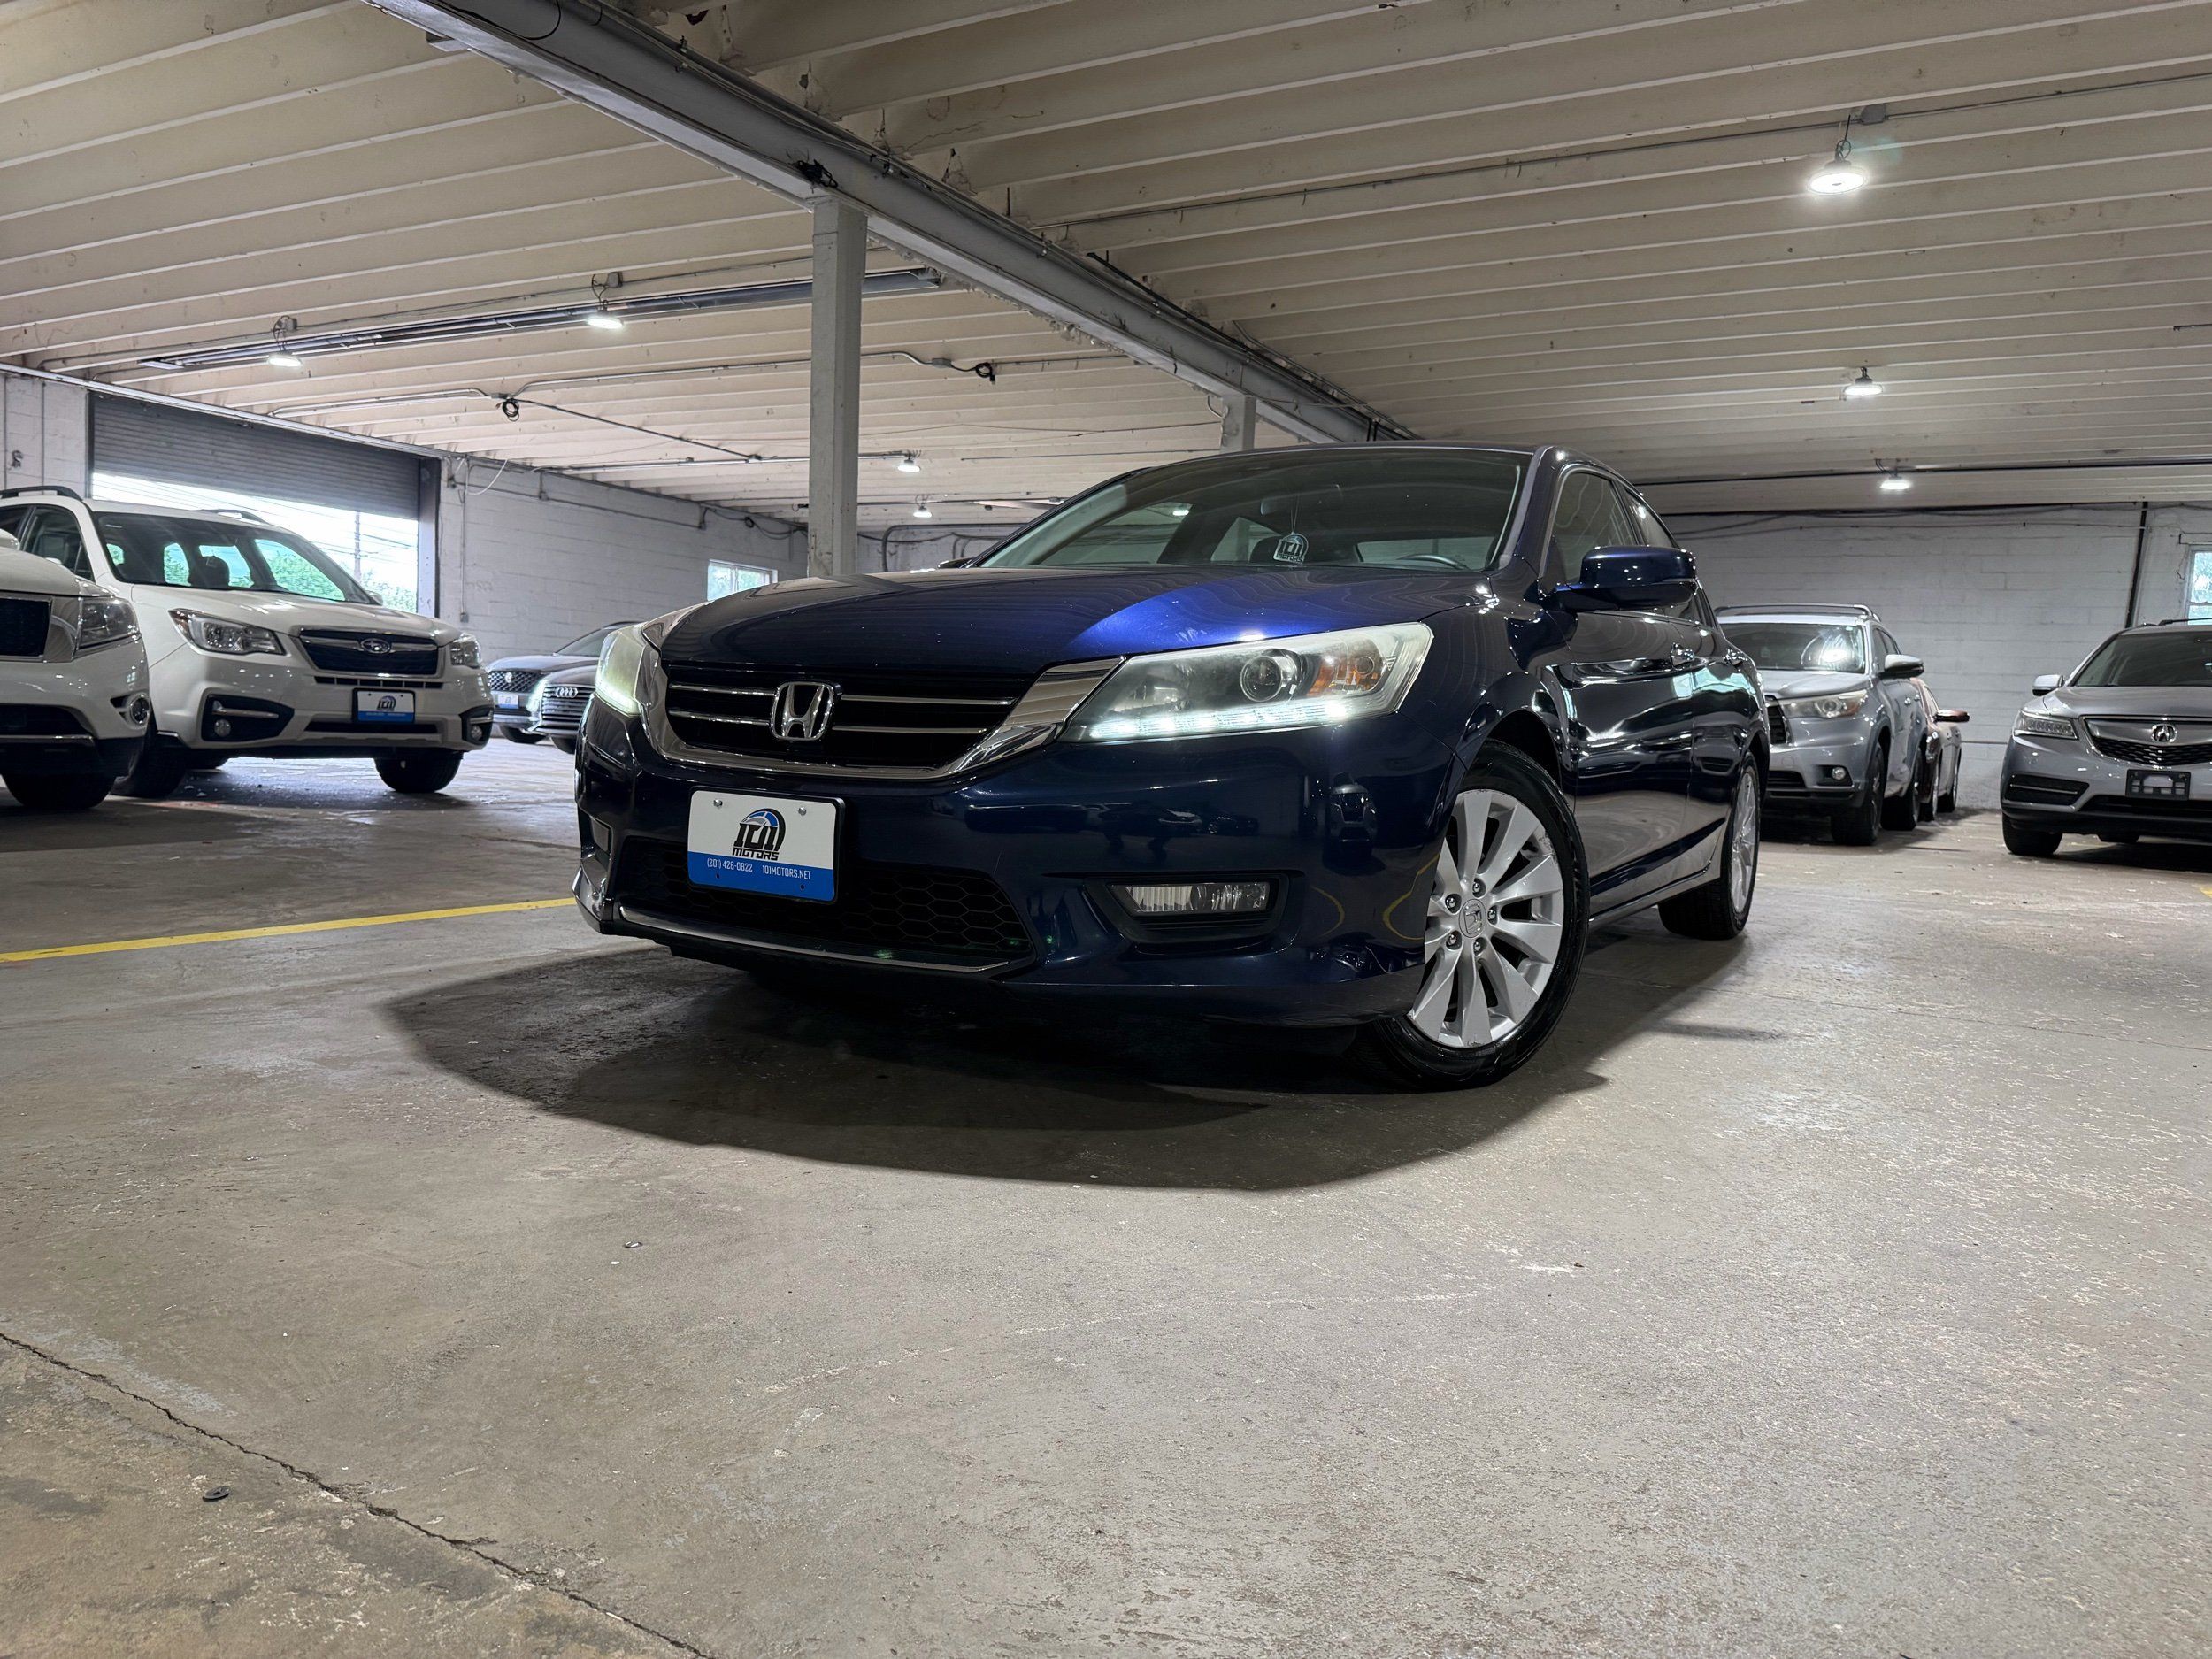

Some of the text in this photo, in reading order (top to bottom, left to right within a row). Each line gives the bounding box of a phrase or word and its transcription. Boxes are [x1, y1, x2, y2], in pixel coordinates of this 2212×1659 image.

[733, 823, 779, 851] 101
[733, 848, 780, 861] MOTORS
[707, 857, 811, 879] (201) 426-0822 101MOTORS.NET
